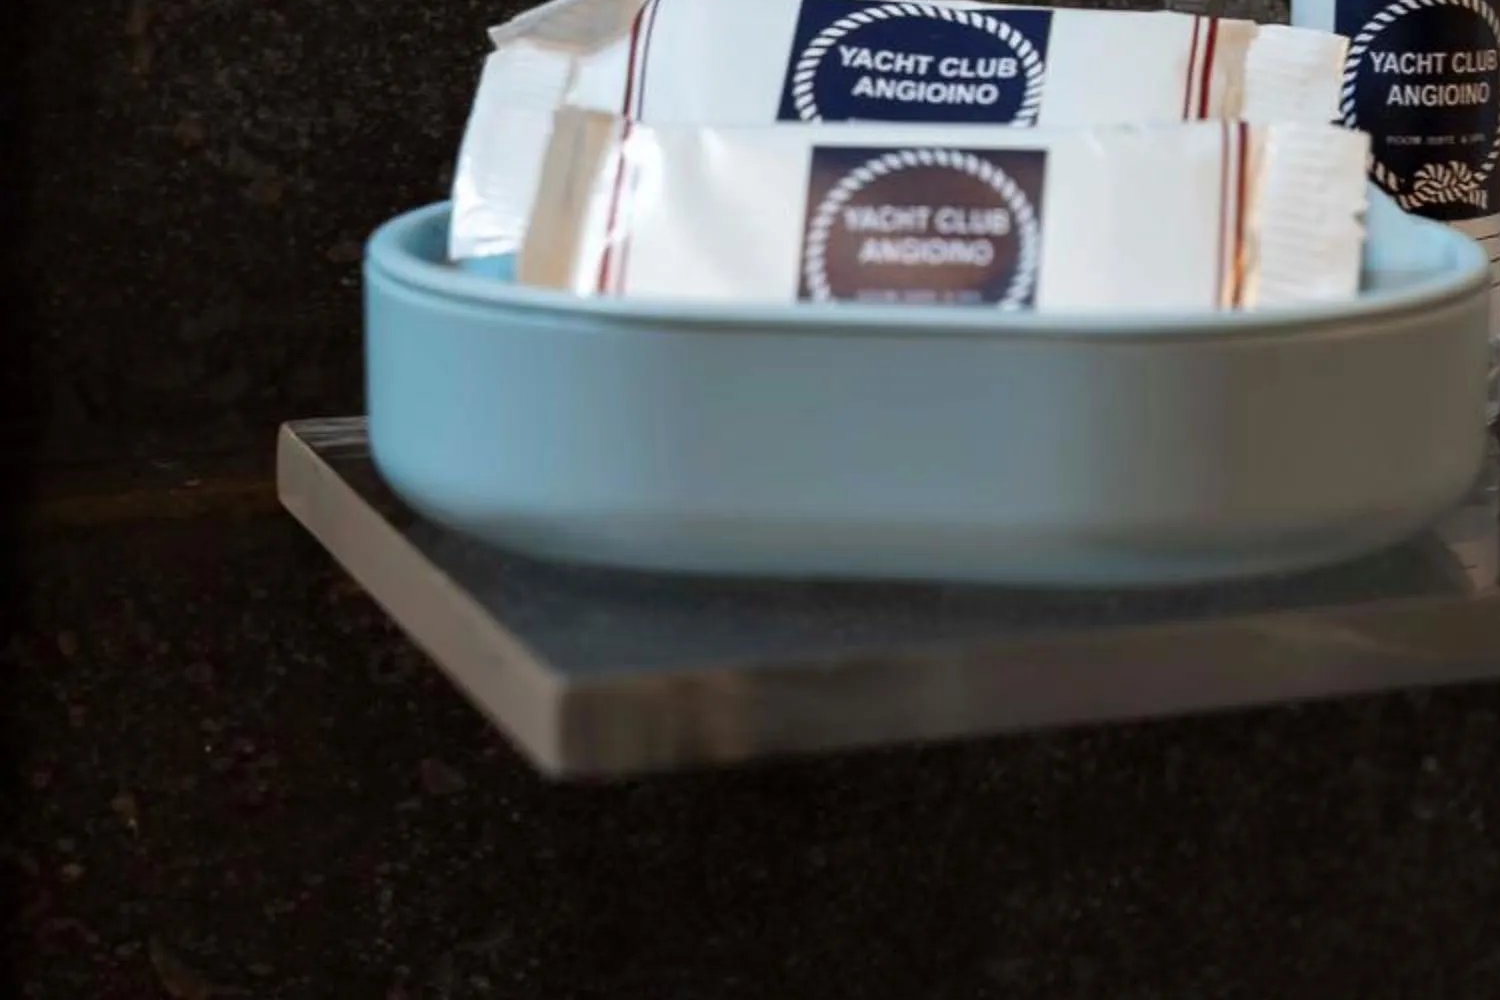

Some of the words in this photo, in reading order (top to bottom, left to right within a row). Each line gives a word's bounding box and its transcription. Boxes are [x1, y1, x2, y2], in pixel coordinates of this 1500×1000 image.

[838, 44, 934, 76] YACHT
[939, 56, 1018, 79] CLUB
[1369, 51, 1446, 75] YACHT
[1451, 49, 1498, 74] CLUB
[852, 75, 999, 105] ANGIOINO
[1386, 81, 1490, 106] ANGIOINO
[844, 205, 931, 232] YACHT
[934, 207, 1011, 236] CLUB
[857, 237, 995, 267] ANGIOINO
